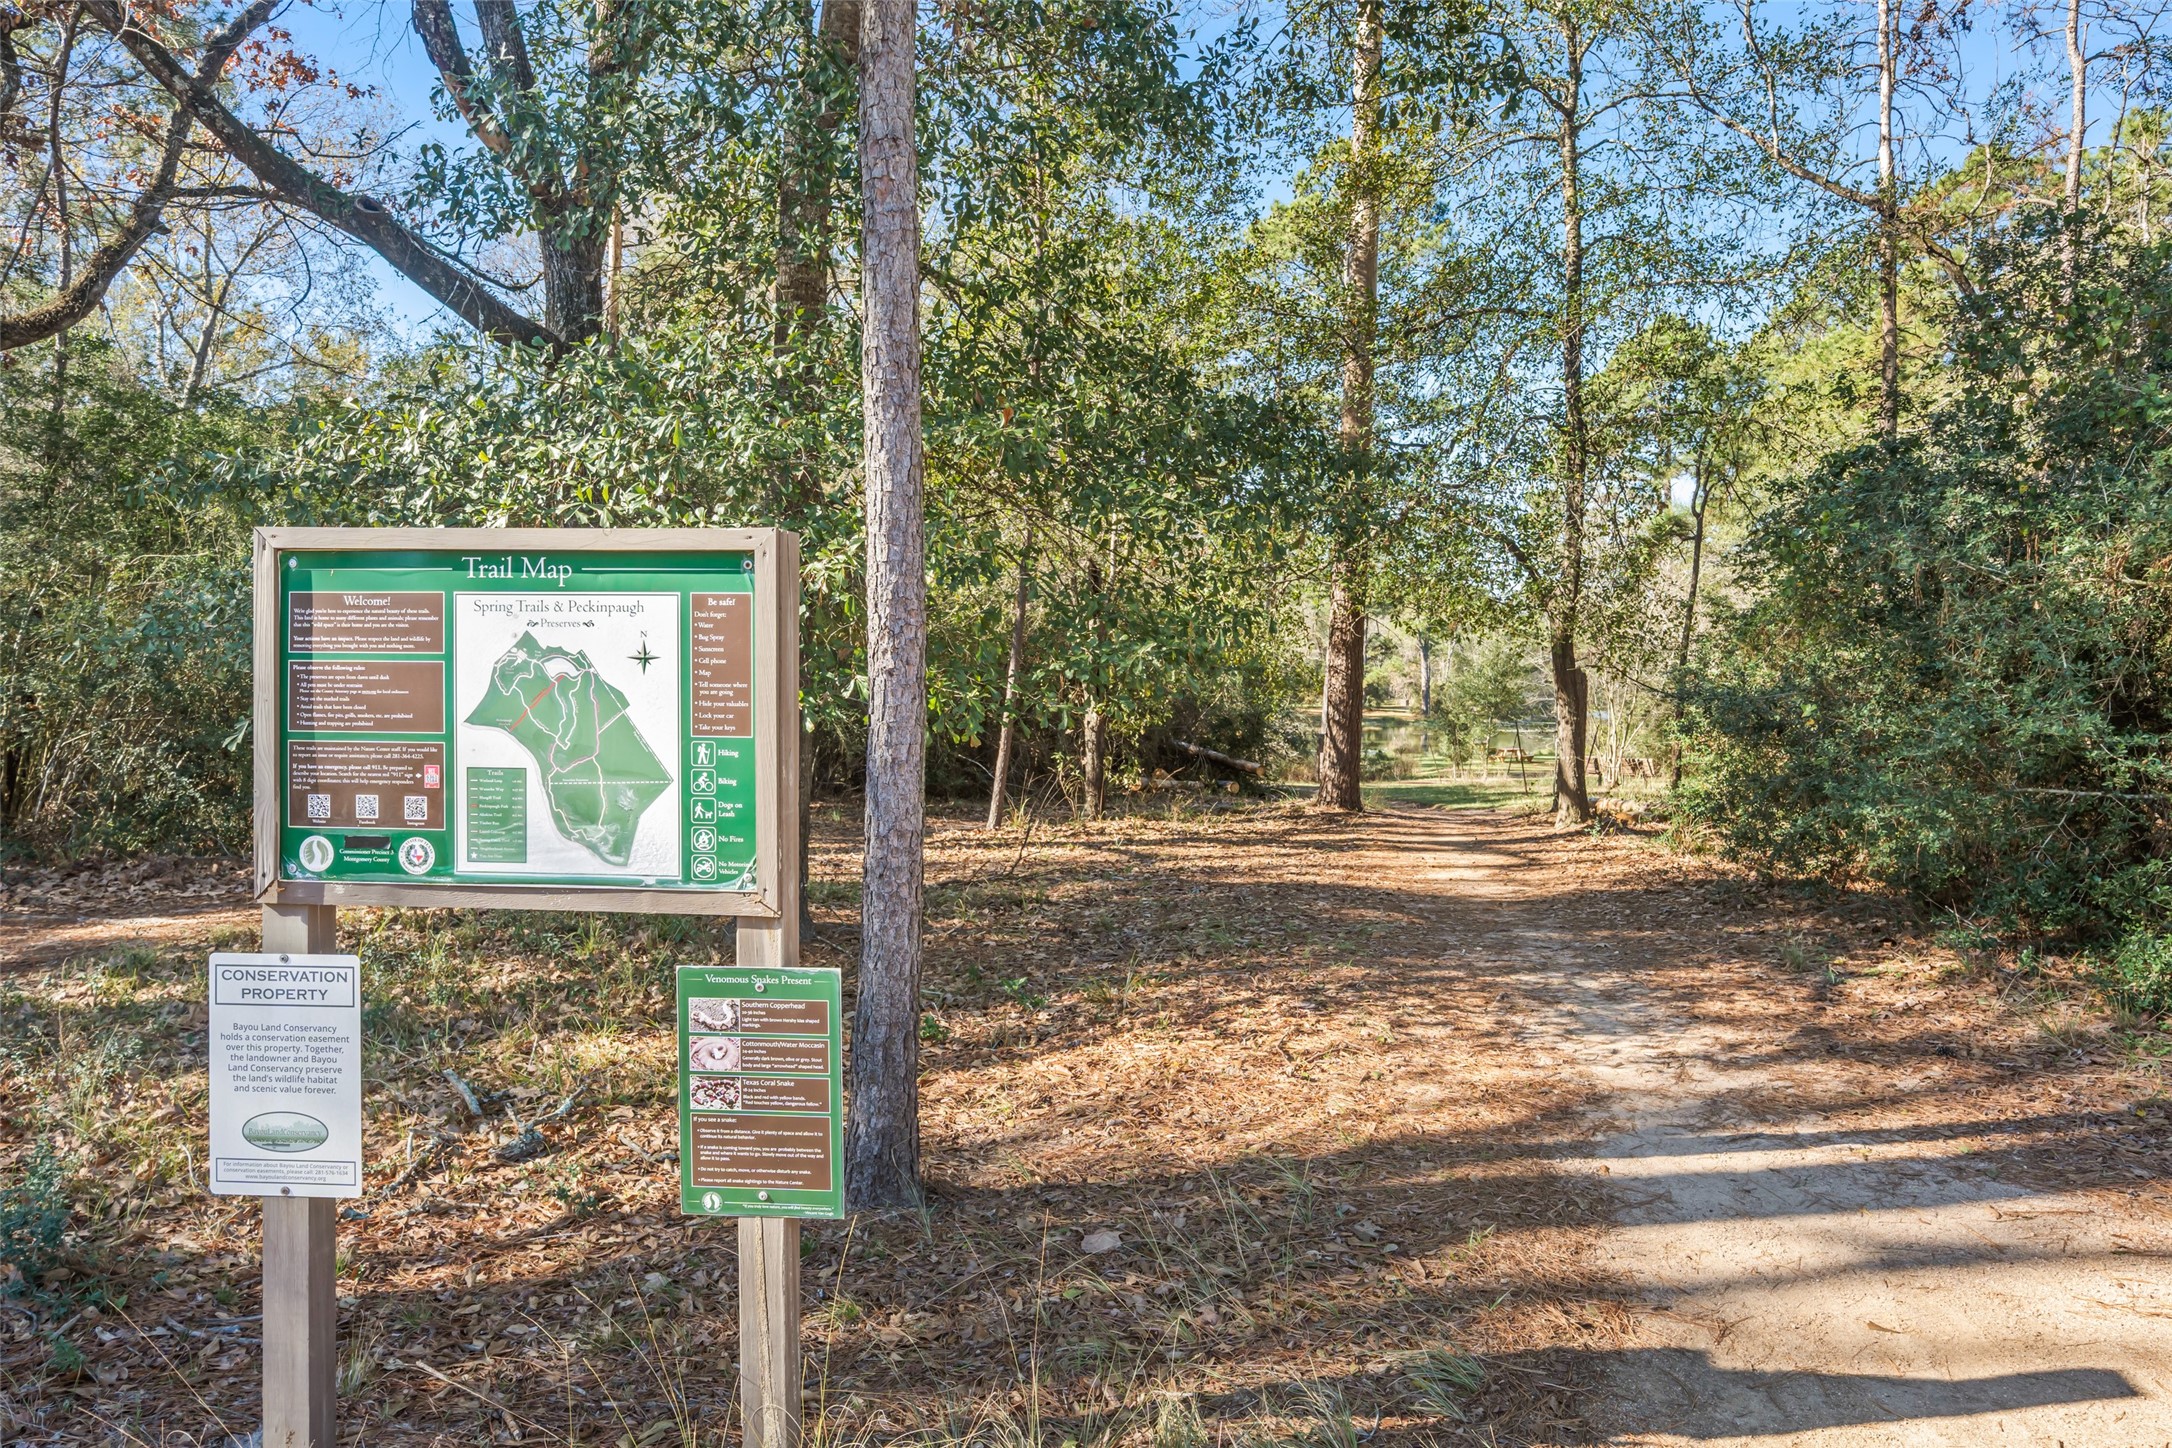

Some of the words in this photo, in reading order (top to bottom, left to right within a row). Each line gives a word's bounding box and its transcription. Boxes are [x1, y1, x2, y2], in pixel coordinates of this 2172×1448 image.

[462, 556, 513, 578] Trail
[521, 557, 572, 587] Map
[344, 595, 390, 606] Welcome!
[474, 600, 513, 616] Spring
[517, 600, 550, 613] Trails
[554, 601, 564, 613] &
[568, 600, 644, 617] Peckinpaugh
[540, 618, 581, 628] Preserves
[718, 778, 737, 786] Biking
[222, 970, 348, 982] CONSERVATION
[705, 974, 749, 984] Venomous
[751, 975, 779, 984] Snakes
[782, 975, 812, 985] Present
[242, 988, 328, 1000] PROPERTY
[233, 1023, 259, 1032] Bayou
[284, 1024, 337, 1034] Conservancy
[252, 1034, 306, 1042] conservation
[246, 1043, 262, 1051] this
[264, 1045, 302, 1054] property.
[305, 1045, 344, 1054] Together,
[246, 1054, 291, 1062] landowner
[311, 1056, 337, 1065] Bayou
[250, 1064, 303, 1074] Conservancy
[275, 1075, 305, 1083] wildlife
[307, 1076, 337, 1084] habitat
[304, 1086, 336, 1094] forever.
[249, 1128, 322, 1137] BayouLandConservancy
